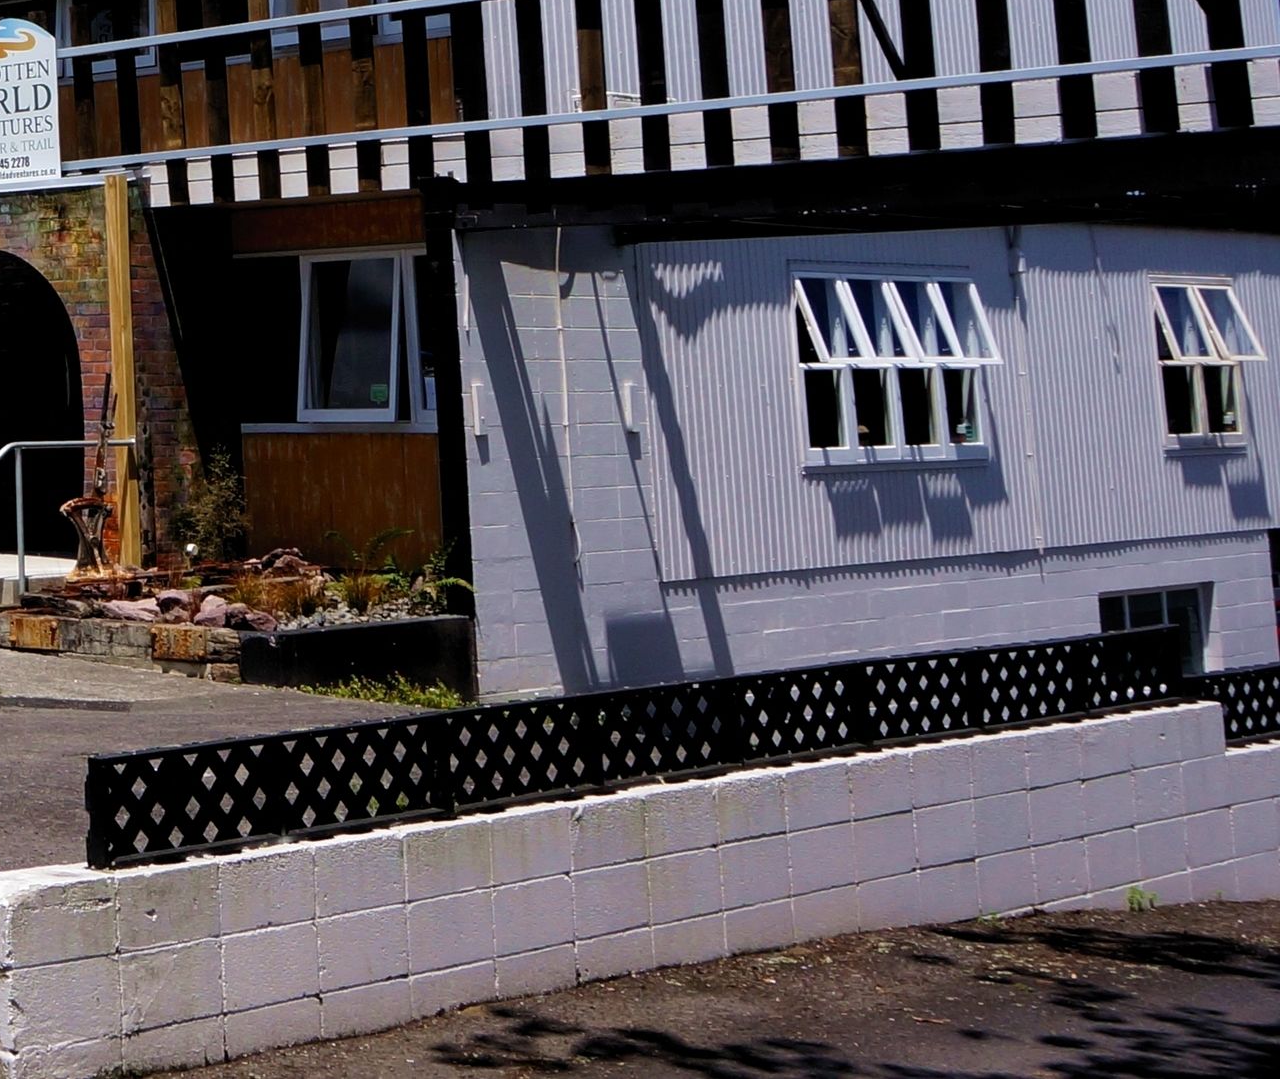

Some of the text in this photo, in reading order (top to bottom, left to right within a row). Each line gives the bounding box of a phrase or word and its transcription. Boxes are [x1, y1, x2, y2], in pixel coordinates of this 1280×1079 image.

[10, 142, 19, 153] &
[21, 138, 55, 152] TRAIL
[11, 156, 31, 169] 2278
